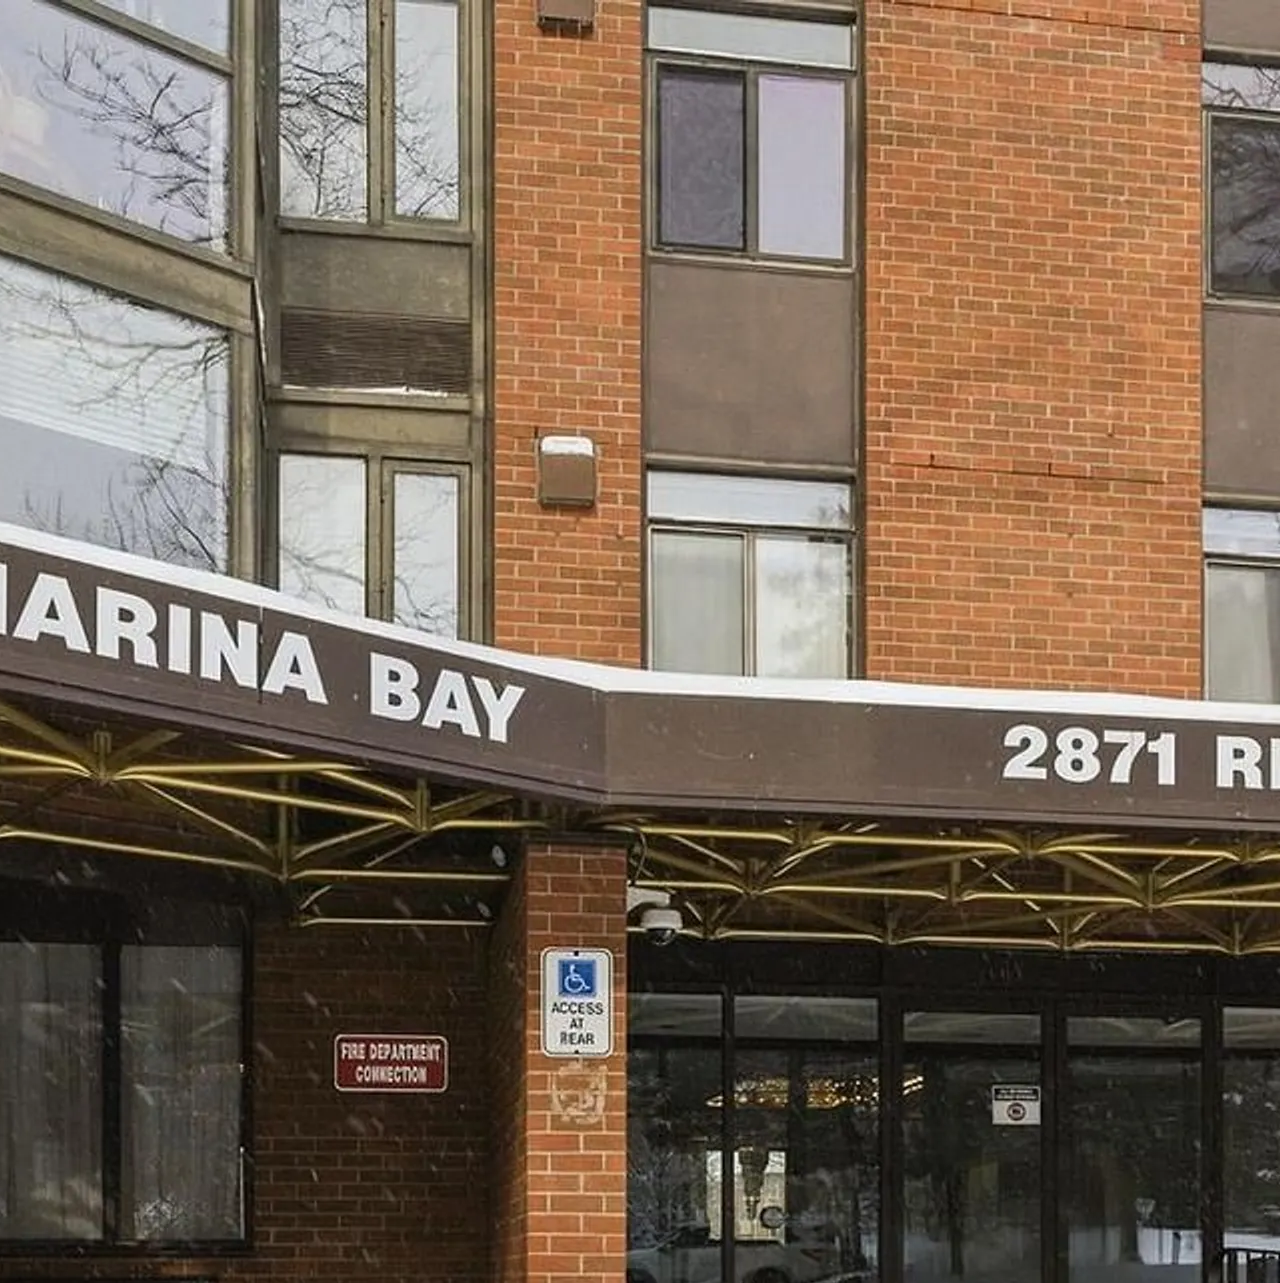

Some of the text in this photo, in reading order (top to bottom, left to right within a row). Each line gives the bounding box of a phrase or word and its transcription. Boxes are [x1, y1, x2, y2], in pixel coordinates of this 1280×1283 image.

[370, 651, 526, 744] BAY
[1002, 723, 1176, 787] 2871
[551, 1001, 604, 1015] ACCESS
[570, 1018, 584, 1030] AT
[560, 1032, 595, 1045] REAR
[341, 1042, 441, 1061] FIRE DEPARTMENT
[355, 1065, 427, 1083] CONNECTION
